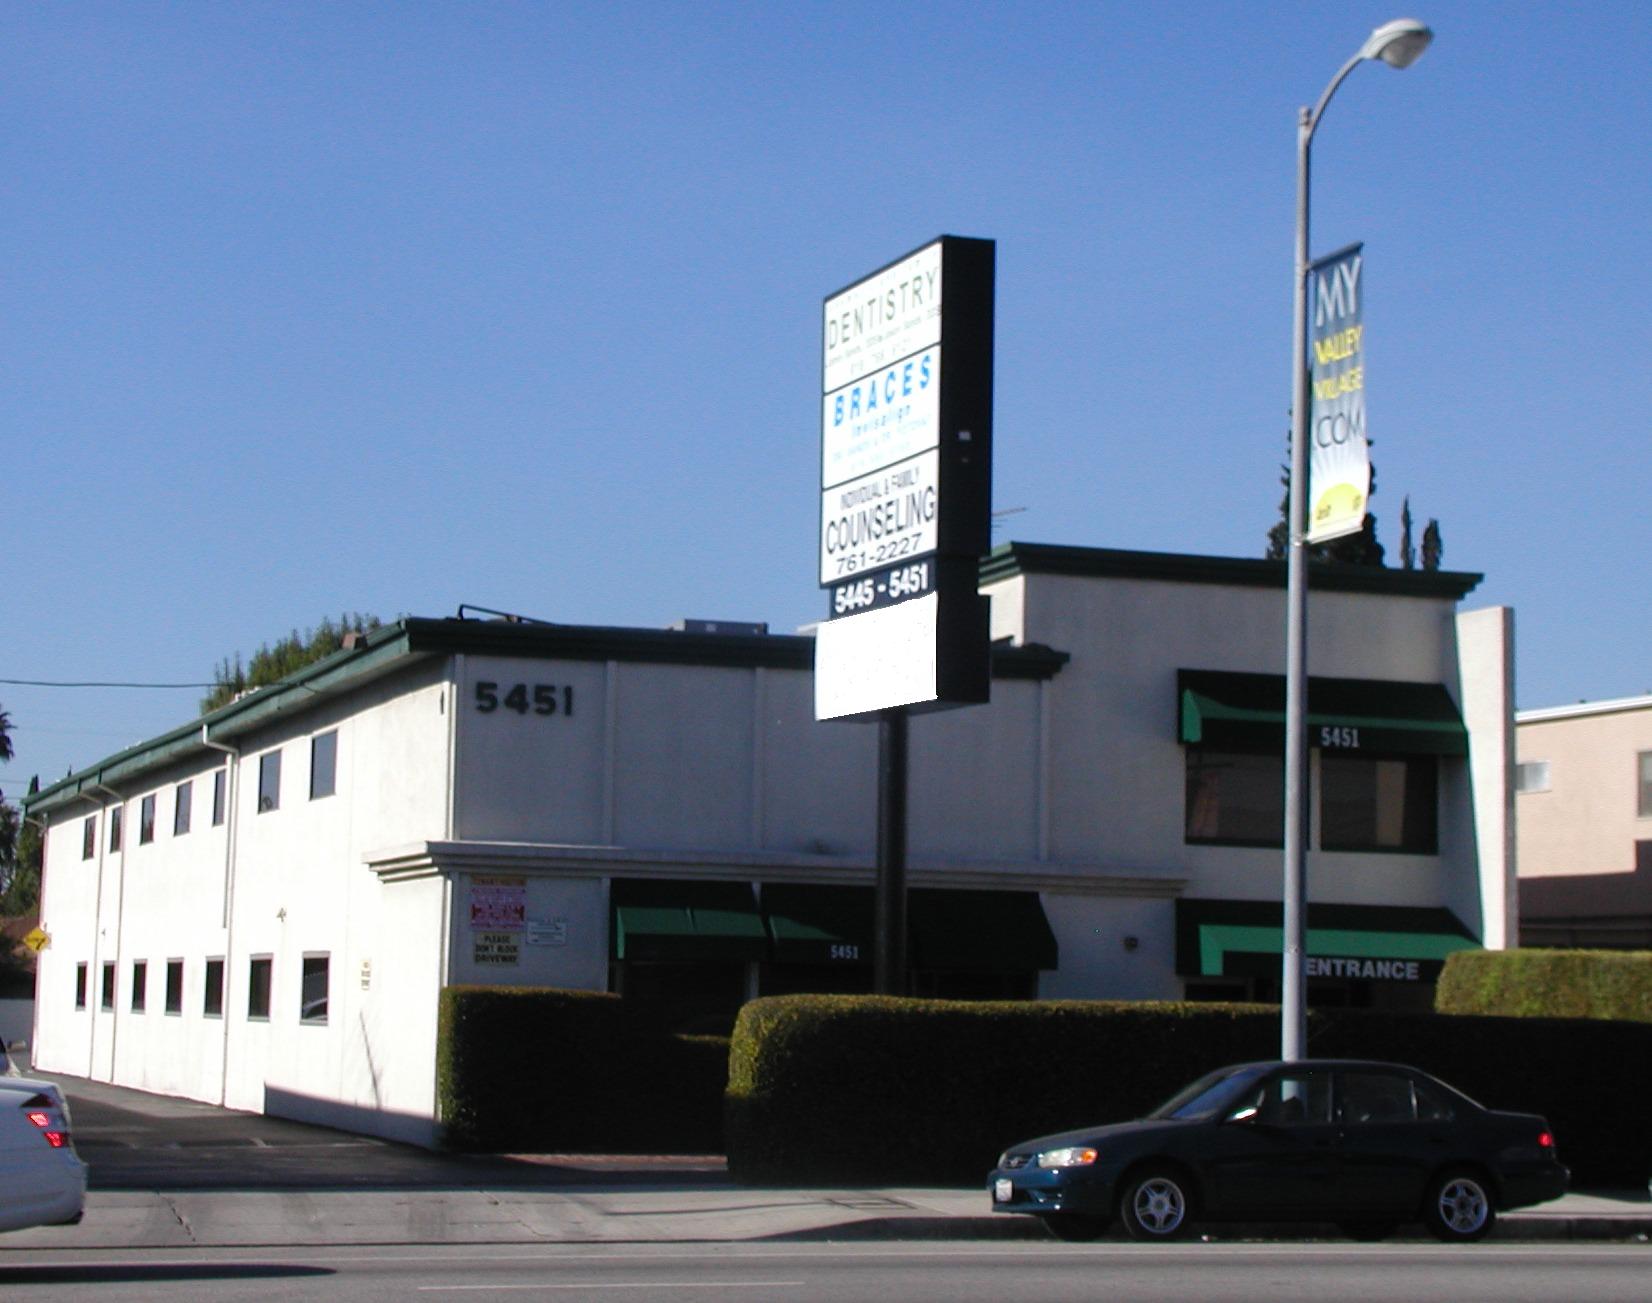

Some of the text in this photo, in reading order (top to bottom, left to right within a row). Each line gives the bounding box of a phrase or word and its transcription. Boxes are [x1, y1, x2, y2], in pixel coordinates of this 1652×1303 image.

[828, 266, 939, 350] DENTISTRY
[1315, 254, 1362, 328] MY
[1314, 324, 1363, 365] VALLEY
[833, 354, 931, 427] BRACES
[1313, 366, 1363, 400] VILLAGE
[839, 481, 882, 510] INDIVIDUAL
[891, 465, 920, 488] FAMILY
[825, 485, 937, 555] COUNSELING
[836, 532, 923, 575] 761-2227
[834, 578, 875, 614] 5445
[888, 562, 929, 598] 5451
[475, 681, 573, 716] 5451
[1320, 726, 1360, 748] 5451
[484, 935, 511, 943] PLEASE
[497, 944, 518, 953] BLOCK
[830, 944, 858, 959] 5451
[474, 954, 518, 963] DRIVEWAY
[1305, 957, 1420, 981] ENTRANCE
